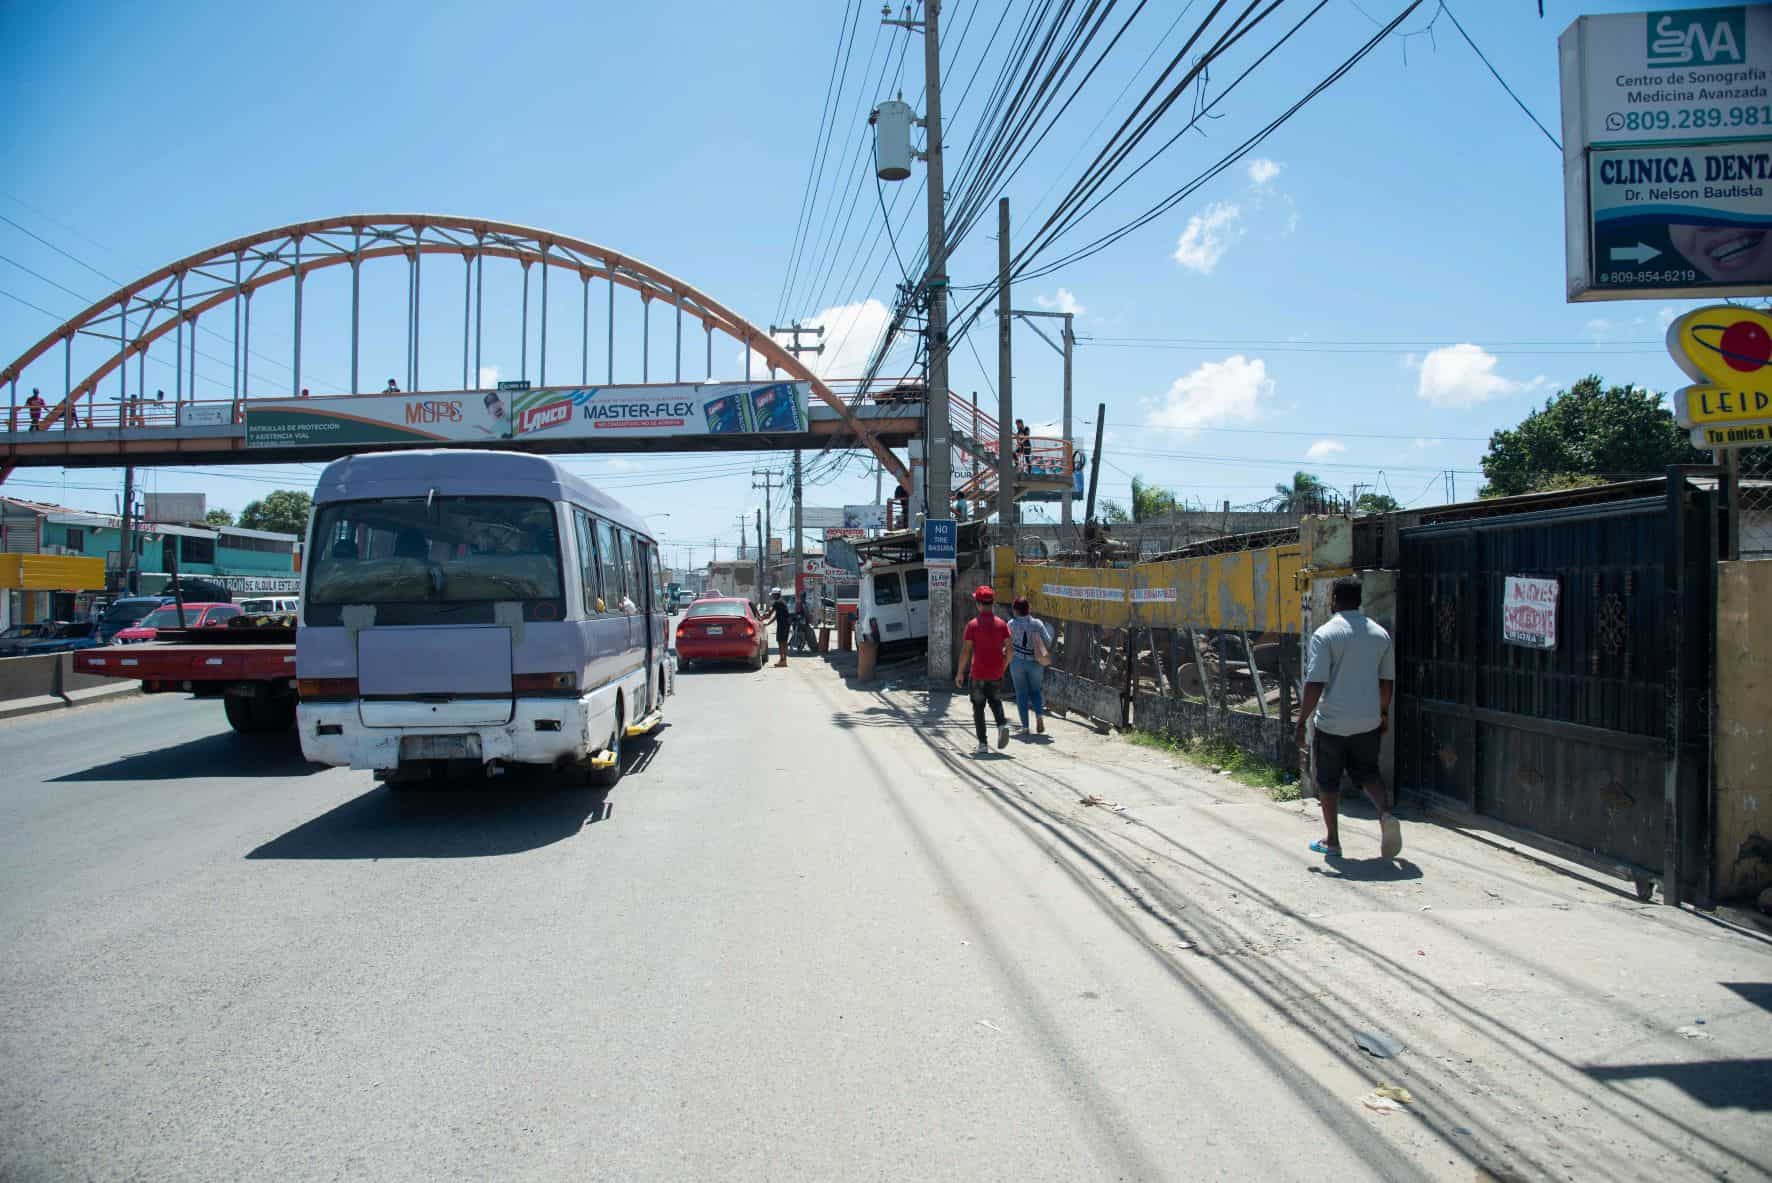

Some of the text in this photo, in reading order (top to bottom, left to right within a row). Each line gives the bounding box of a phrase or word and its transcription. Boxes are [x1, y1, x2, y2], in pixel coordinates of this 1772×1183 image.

[1616, 73, 1663, 87] Centro
[1667, 72, 1685, 84] de
[1627, 86, 1768, 104] Medicina Avanzada
[1600, 153, 1772, 185] CLINICA DENT
[1625, 185, 1763, 201] Dr. Nelson Bautista
[523, 406, 568, 431] LANCO
[584, 402, 694, 419] MASTER-FLEX
[1707, 429, 1723, 443] Tu
[1727, 426, 1765, 442] única
